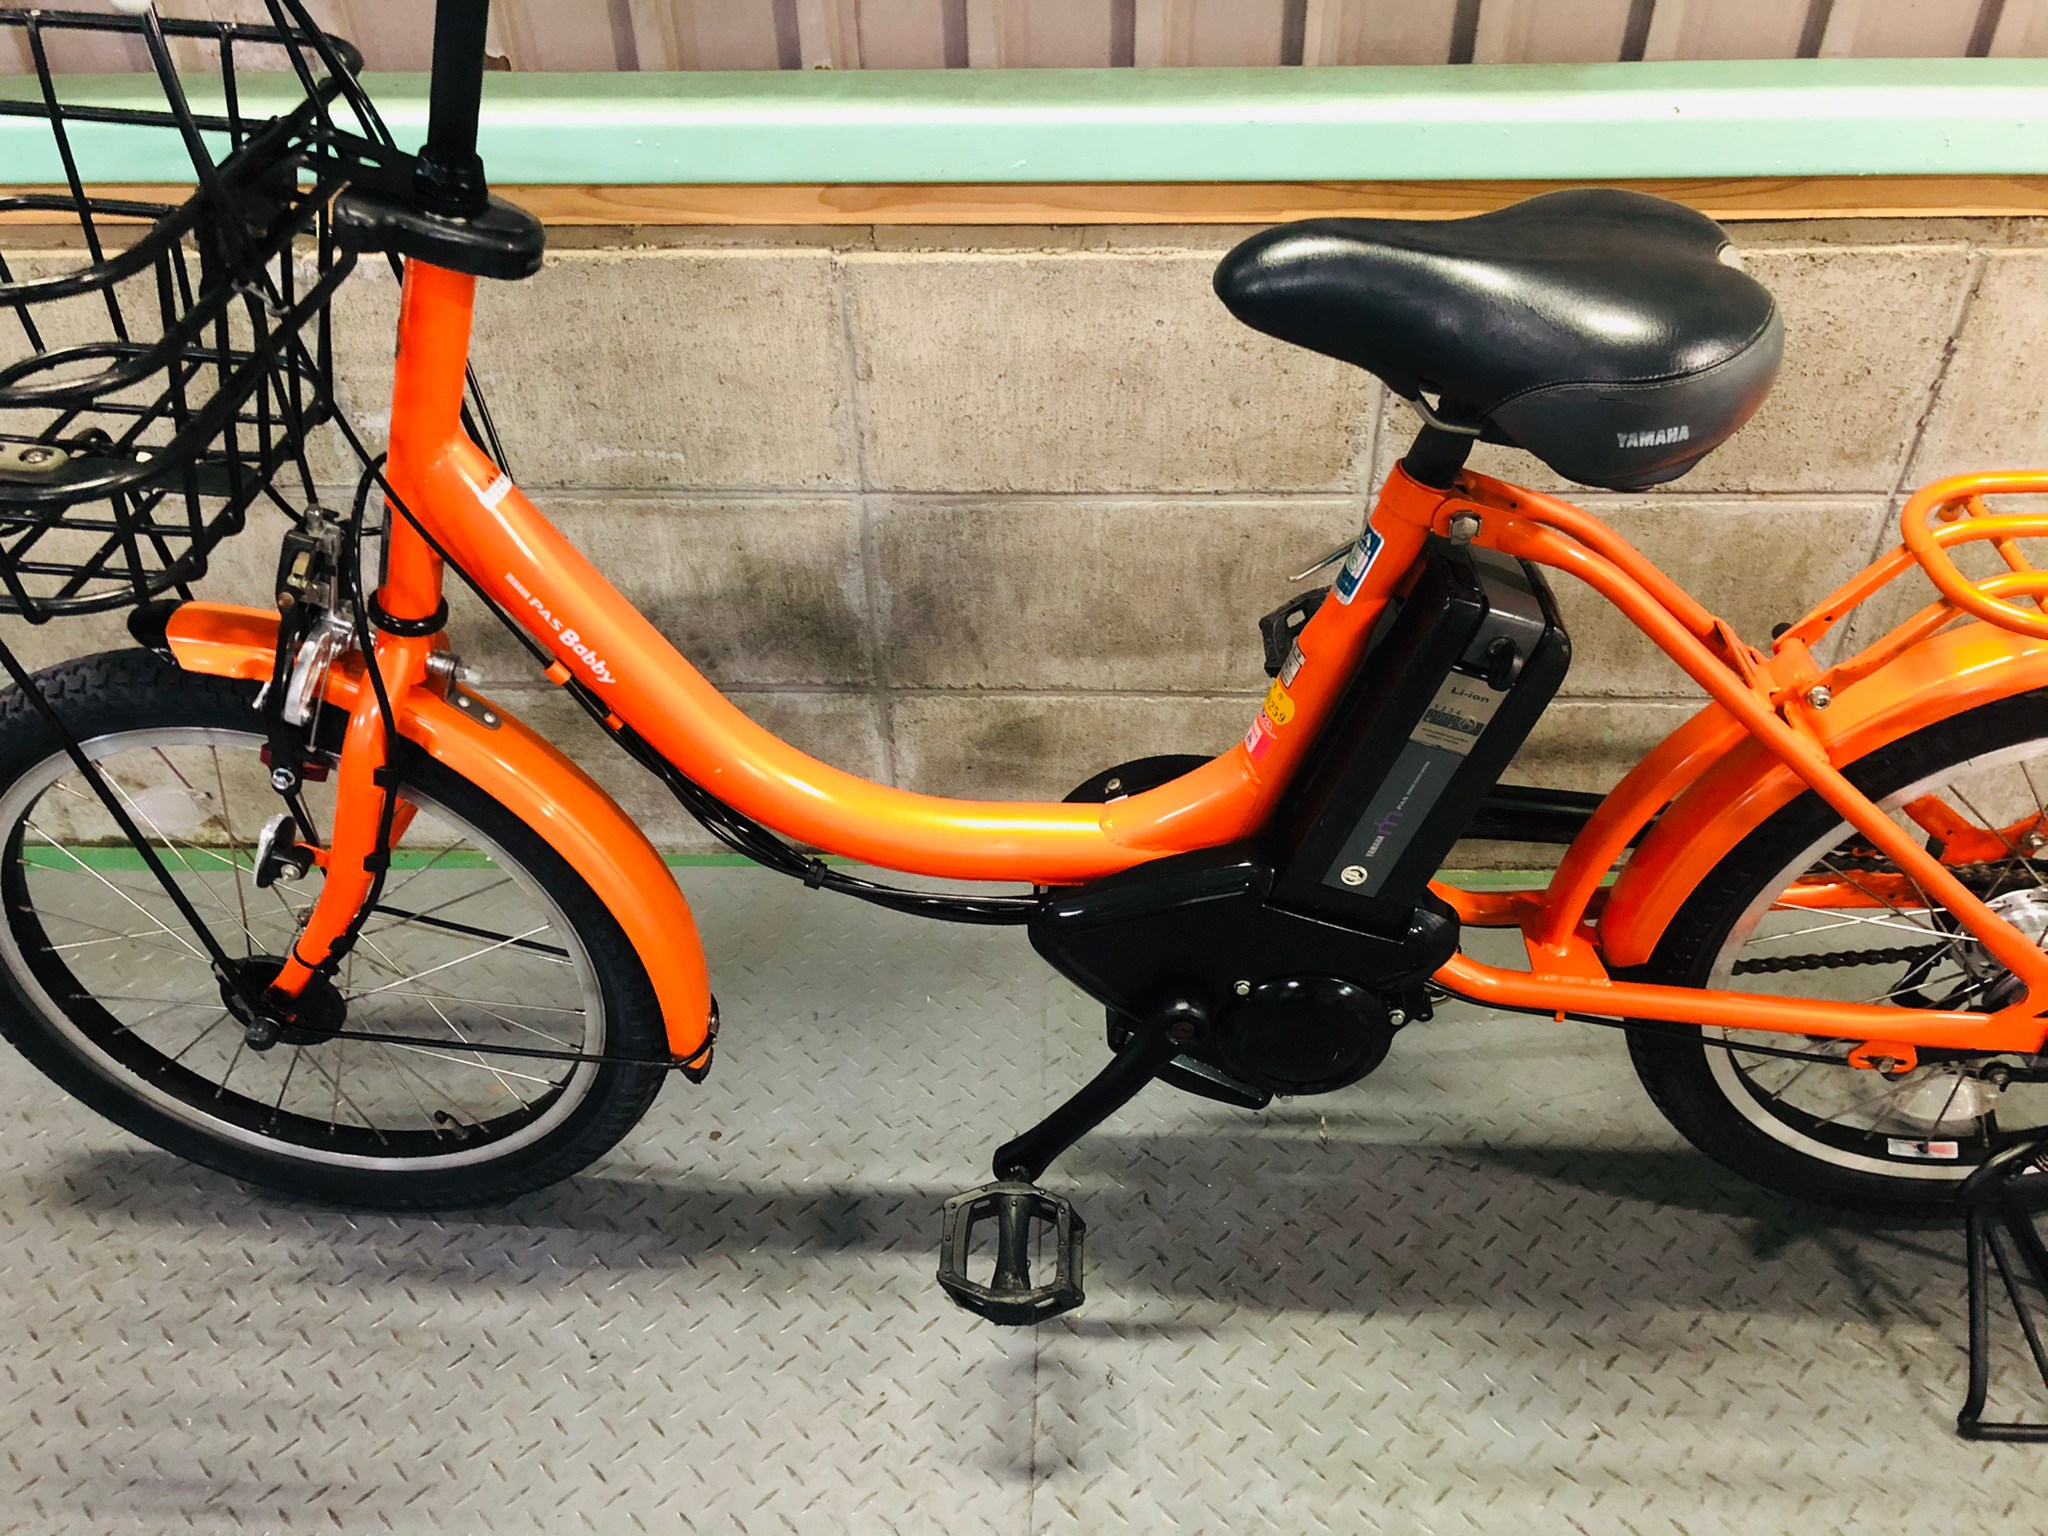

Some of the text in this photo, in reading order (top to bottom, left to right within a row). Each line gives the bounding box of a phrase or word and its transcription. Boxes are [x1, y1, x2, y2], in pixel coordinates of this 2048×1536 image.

[1616, 425, 1690, 448] YAMAHA
[528, 597, 616, 684] PAS Babby
[1450, 687, 1490, 703] Li-ion
[1365, 835, 1385, 858] YAMAHA
